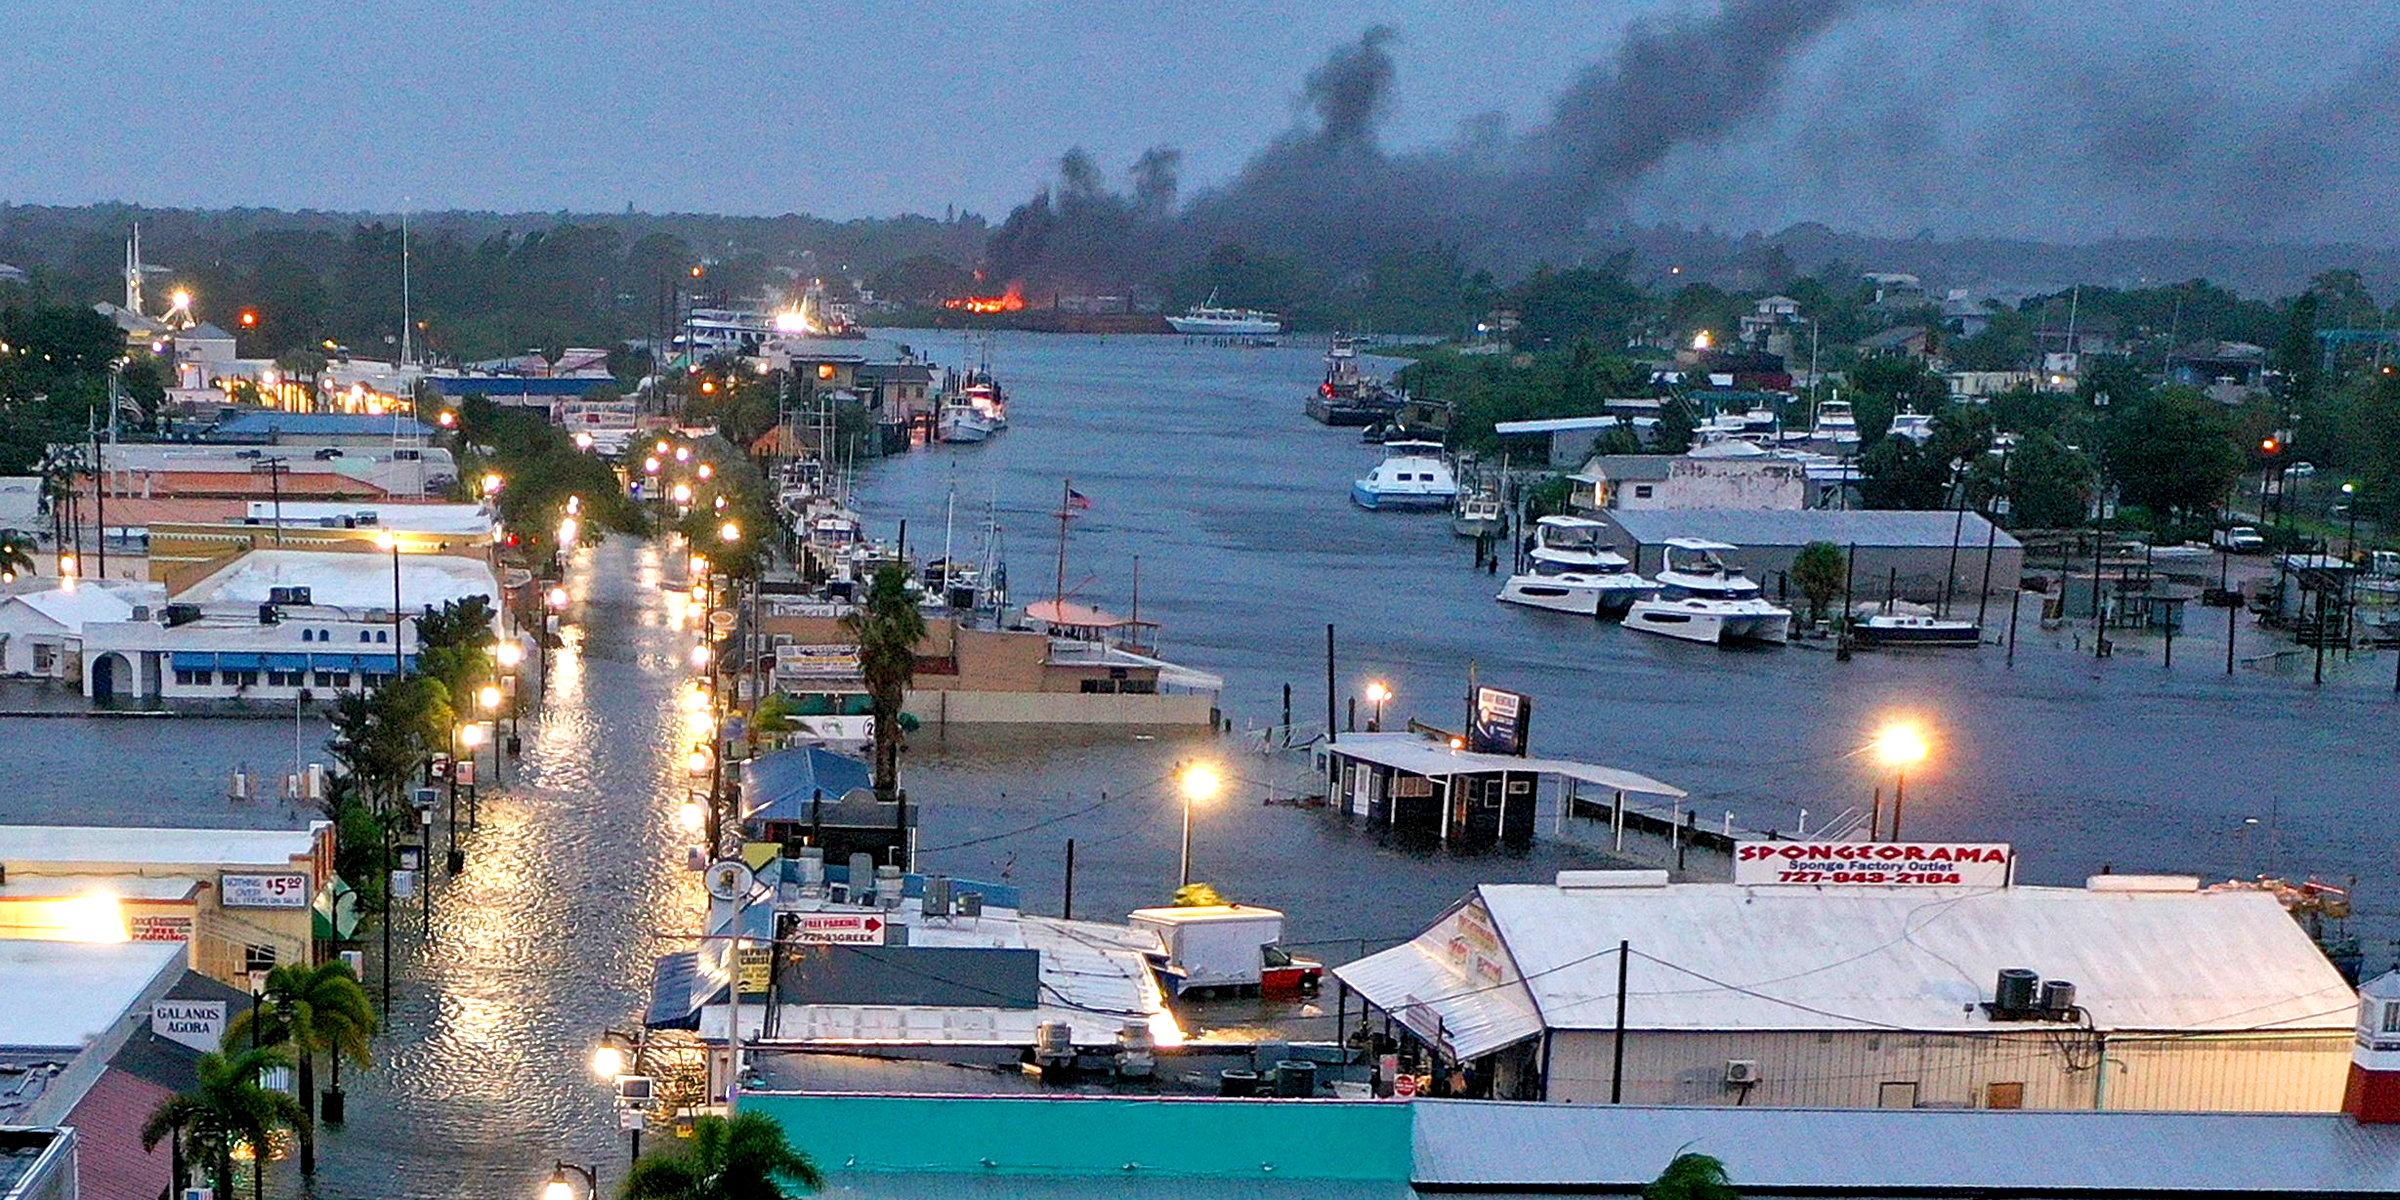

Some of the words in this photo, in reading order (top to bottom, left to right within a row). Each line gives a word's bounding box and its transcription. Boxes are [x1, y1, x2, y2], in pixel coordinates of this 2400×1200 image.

[1739, 845, 2005, 863] SPONGEORAMA
[1789, 860, 1844, 872] Sponge
[1849, 861, 1905, 872] Factory
[1908, 861, 1953, 871] Outlet
[225, 878, 260, 887] NOTHING
[235, 888, 261, 897] OVER
[822, 918, 858, 927] PARKING
[157, 1007, 220, 1020] GALANOS
[167, 1021, 211, 1034] AGORA
